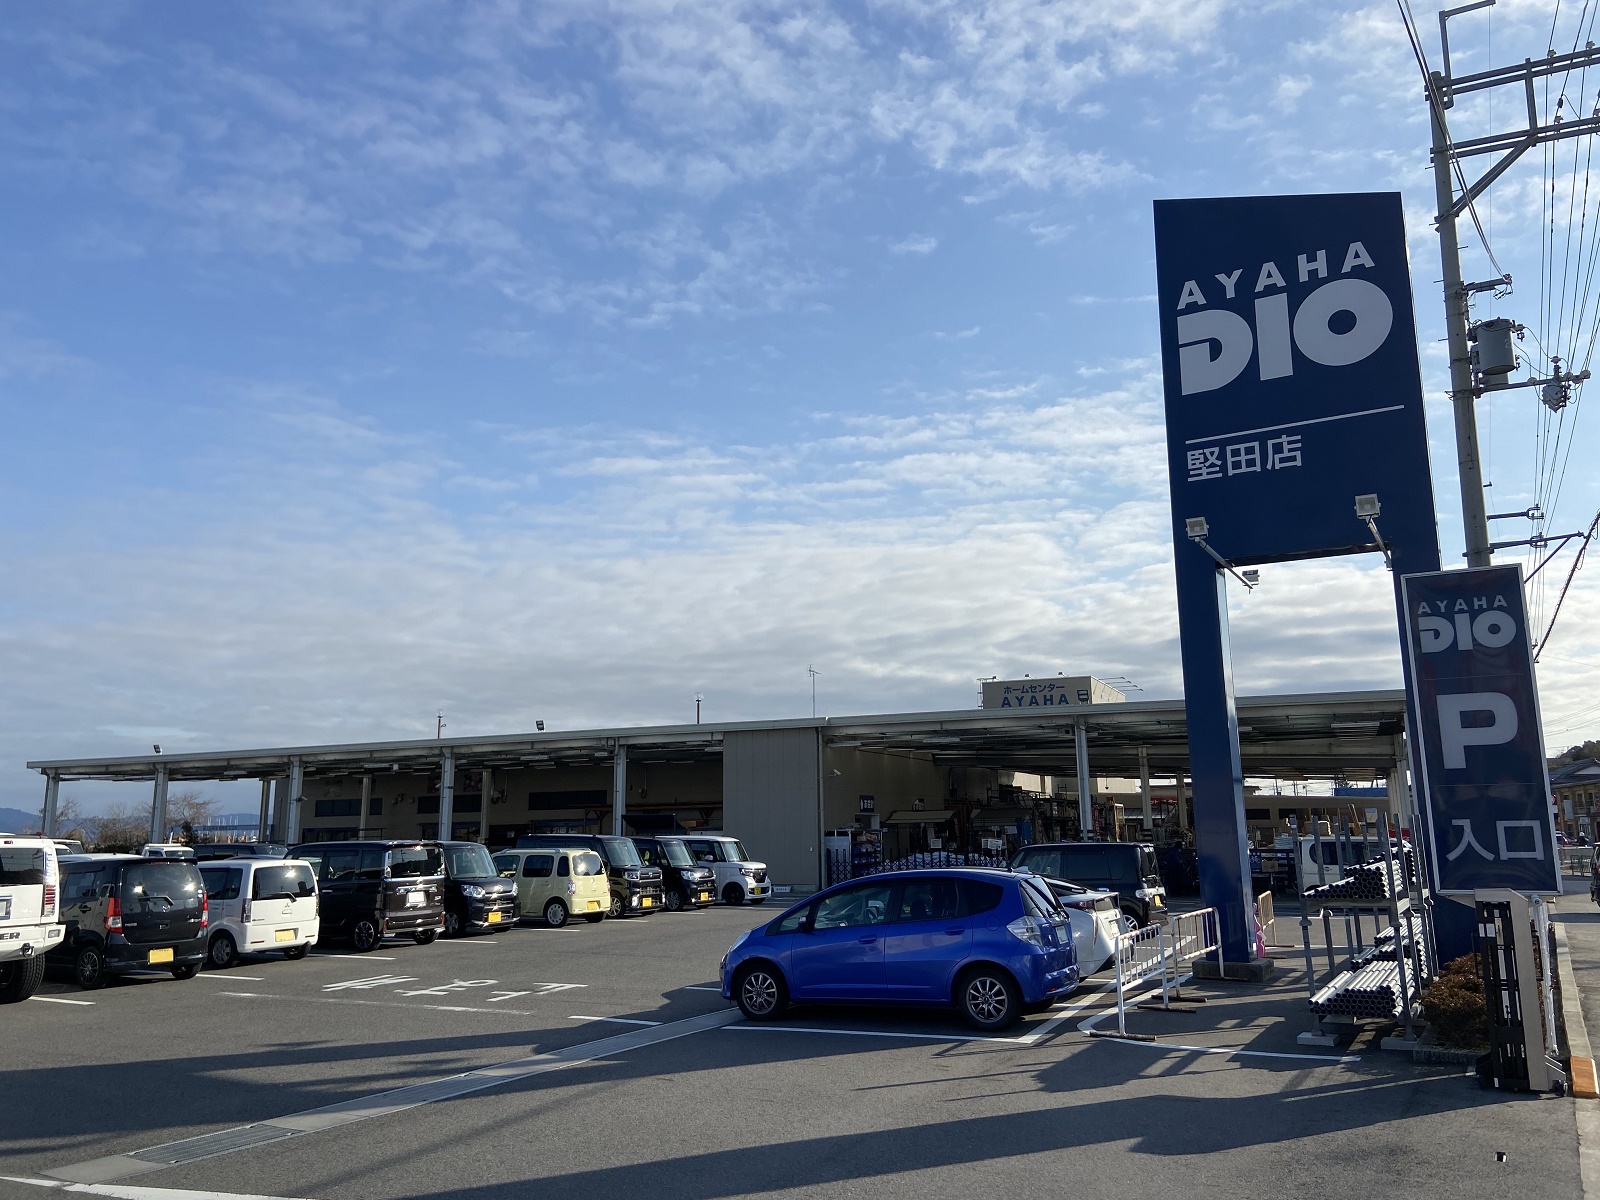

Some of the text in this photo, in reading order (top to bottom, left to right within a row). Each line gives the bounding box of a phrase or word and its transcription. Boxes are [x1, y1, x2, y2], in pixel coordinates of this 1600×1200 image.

[1177, 241, 1375, 310] AYAHA
[1177, 278, 1393, 396] DIO
[1187, 435, 1302, 481] 堅田店
[1417, 594, 1508, 615] AYAHA
[1418, 610, 1517, 654] DIO
[1001, 694, 1069, 707] AYAHA
[1003, 684, 1065, 694] ホームセンター
[1436, 692, 1519, 769] P
[1445, 819, 1546, 862] 入口
